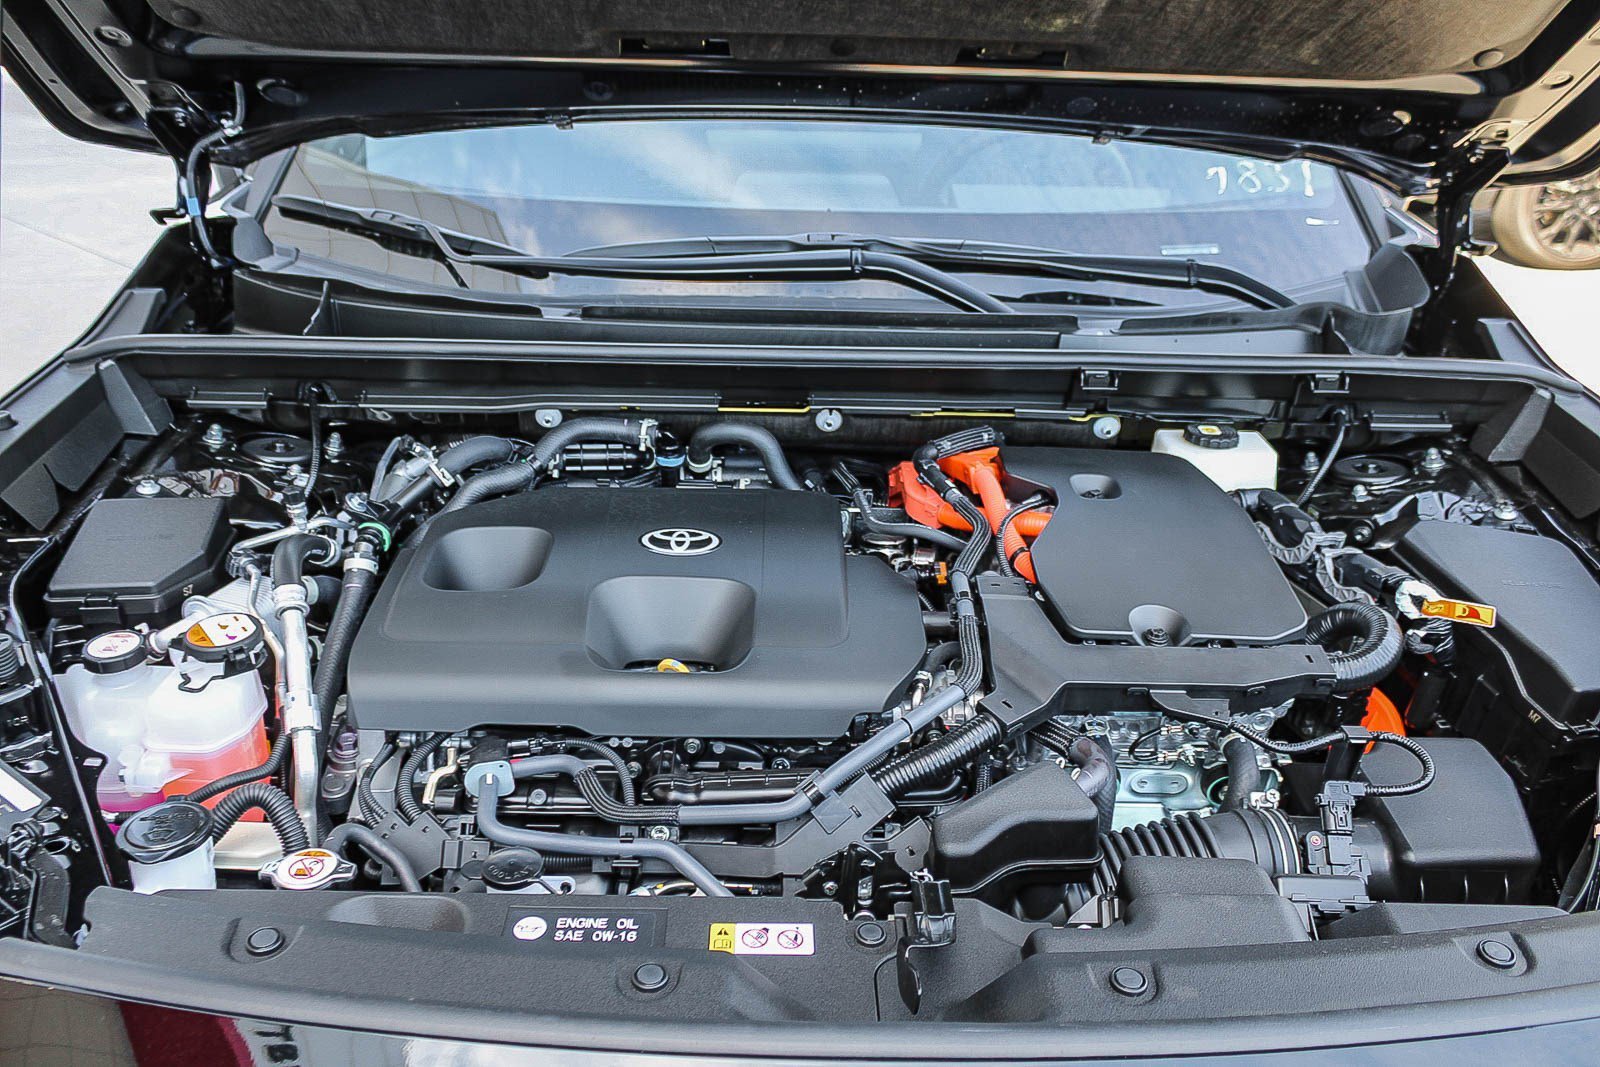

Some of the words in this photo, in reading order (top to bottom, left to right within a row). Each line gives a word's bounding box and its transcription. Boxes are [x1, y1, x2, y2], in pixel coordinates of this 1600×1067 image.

[556, 917, 609, 929] ENGINE
[616, 918, 639, 930] OIL
[553, 930, 585, 942] SAE
[592, 930, 638, 942] 0W-16
